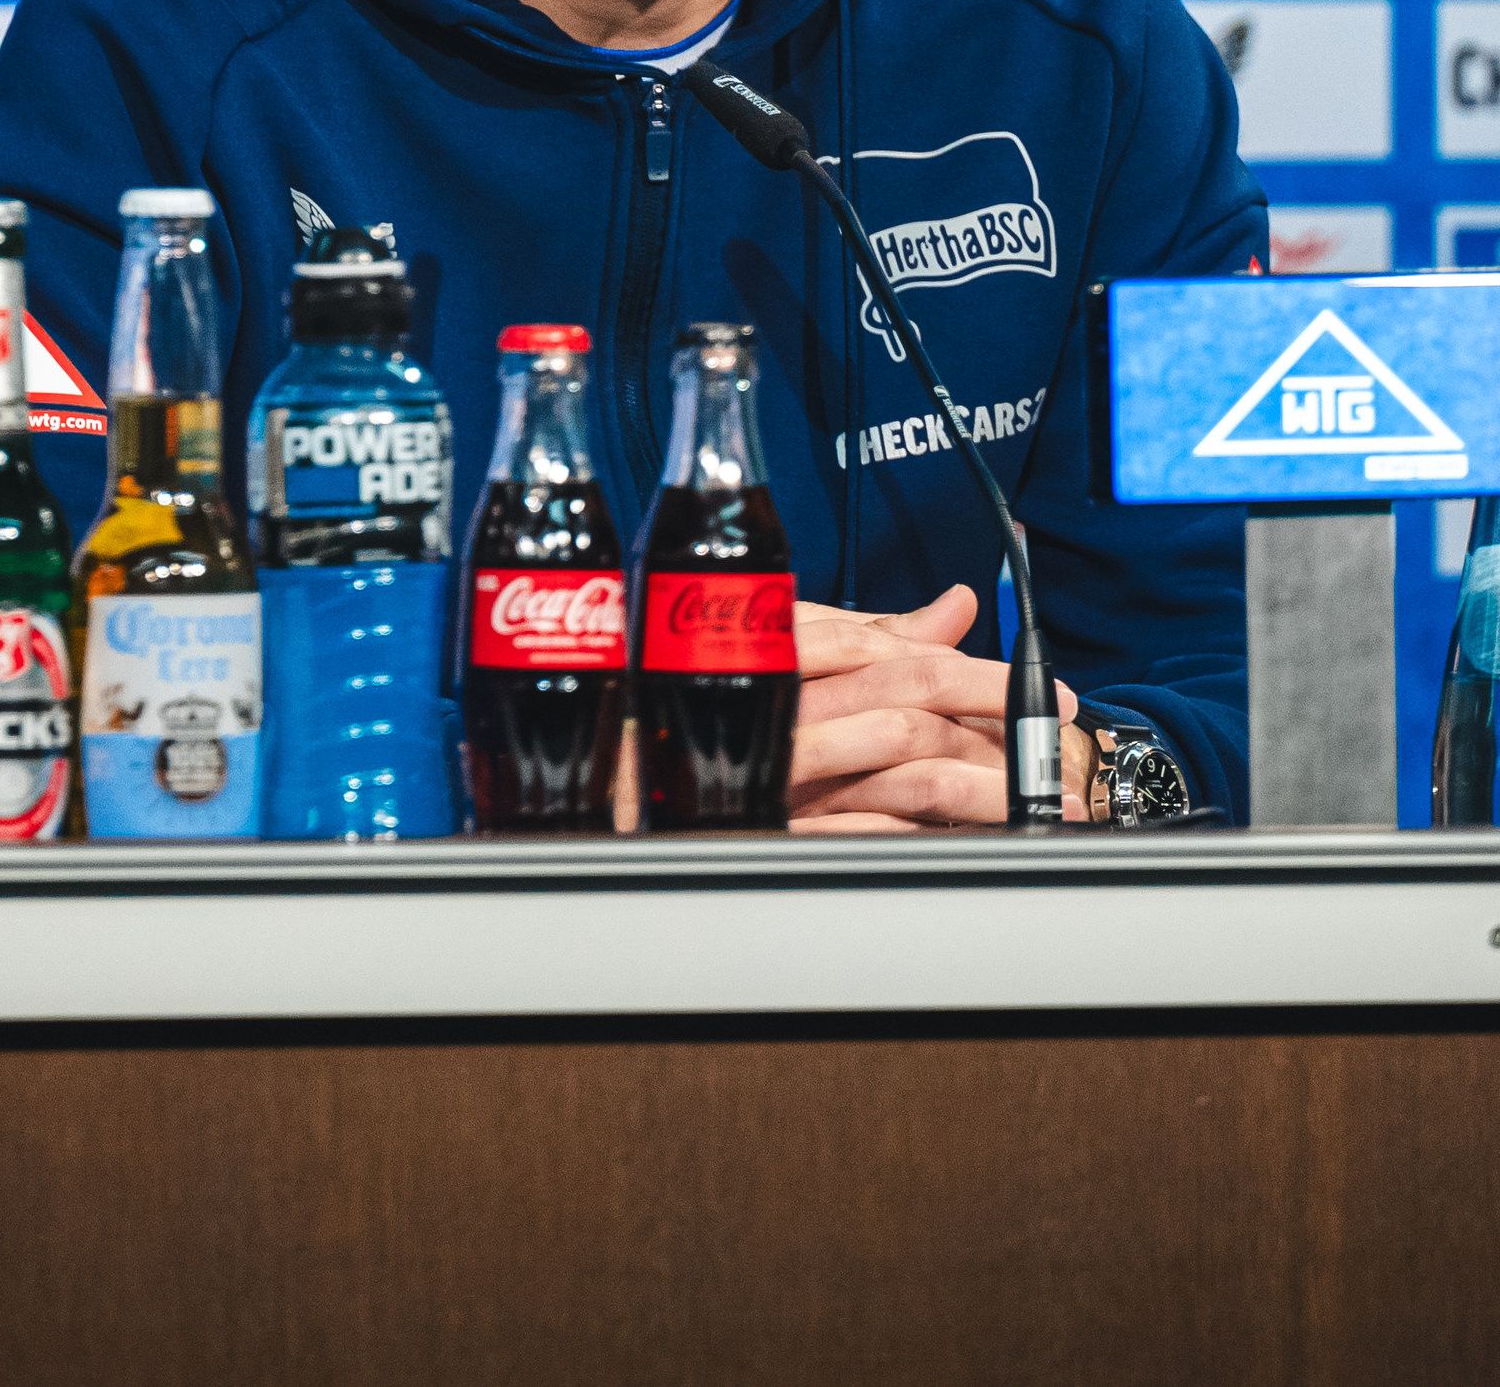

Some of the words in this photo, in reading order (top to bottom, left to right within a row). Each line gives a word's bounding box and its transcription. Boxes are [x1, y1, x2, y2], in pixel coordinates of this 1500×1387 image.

[1281, 375, 1376, 435] WTG
[283, 423, 439, 466] POWER
[360, 461, 442, 504] ADE
